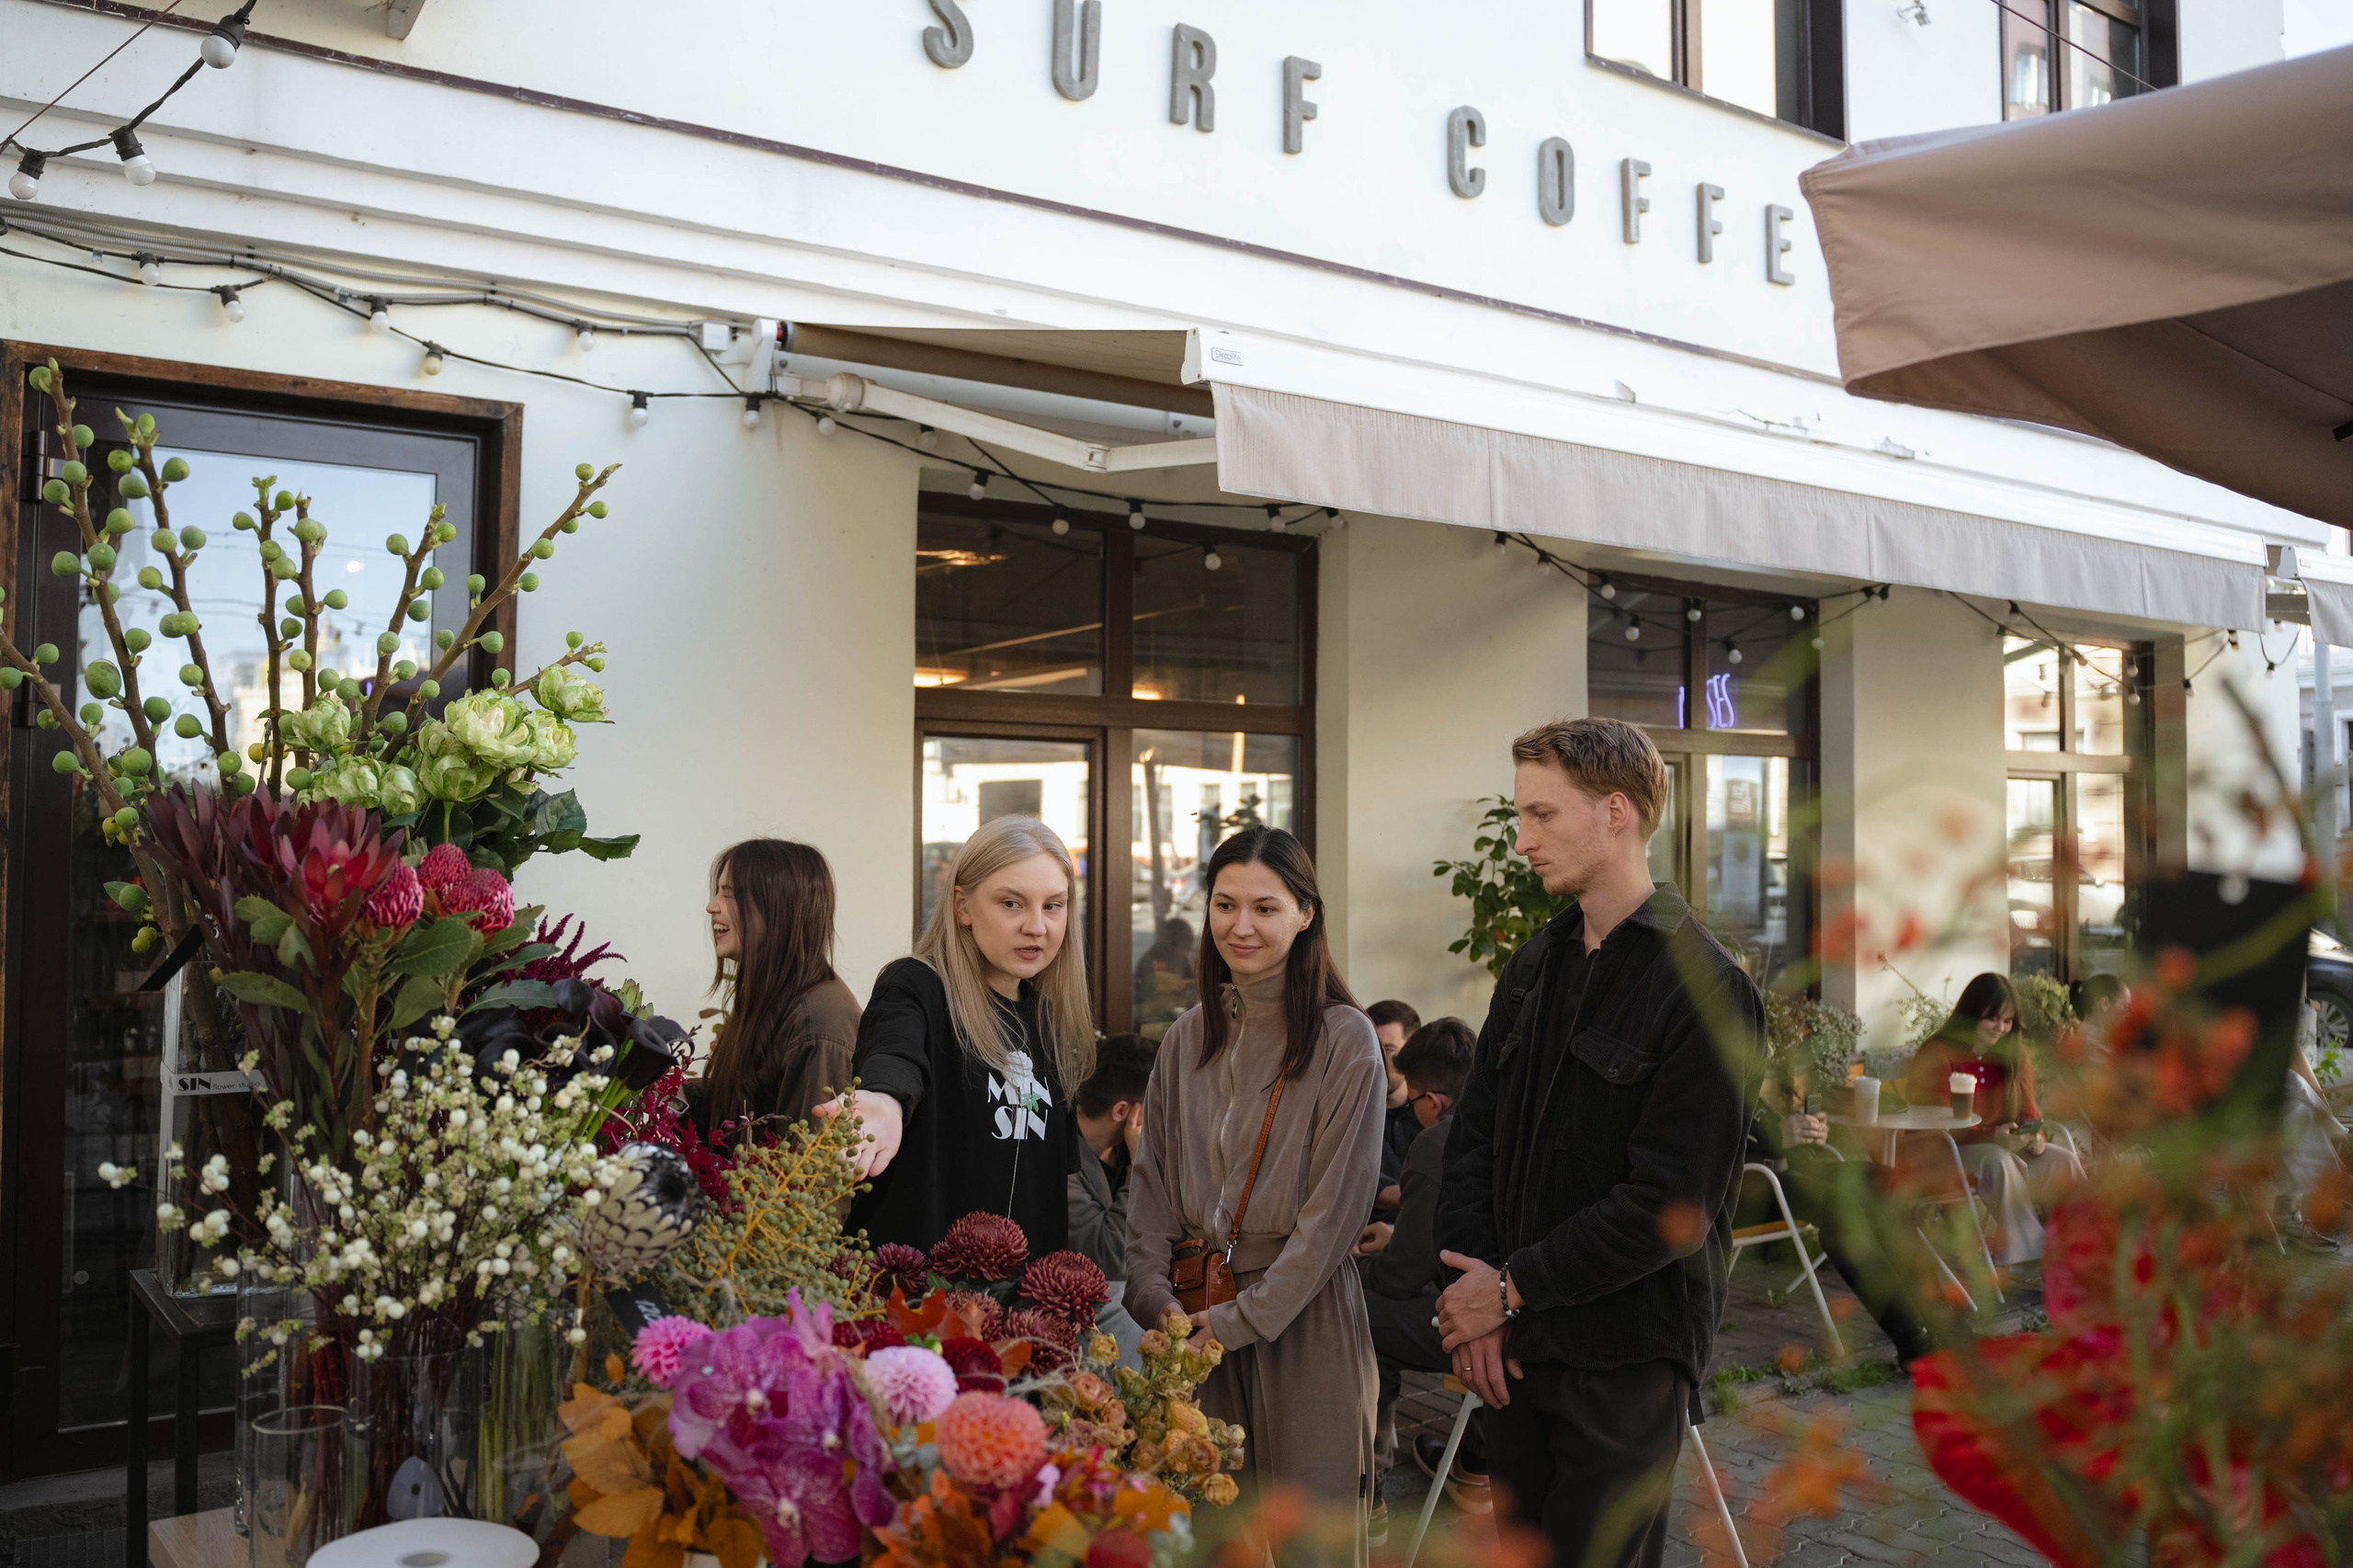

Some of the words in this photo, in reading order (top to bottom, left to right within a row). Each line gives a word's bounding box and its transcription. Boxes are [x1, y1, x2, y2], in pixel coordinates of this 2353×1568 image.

[922, 0, 1323, 154] SURF
[178, 1077, 211, 1091] SIN
[238, 1081, 260, 1089] studio
[992, 1106, 1048, 1141] SIN
